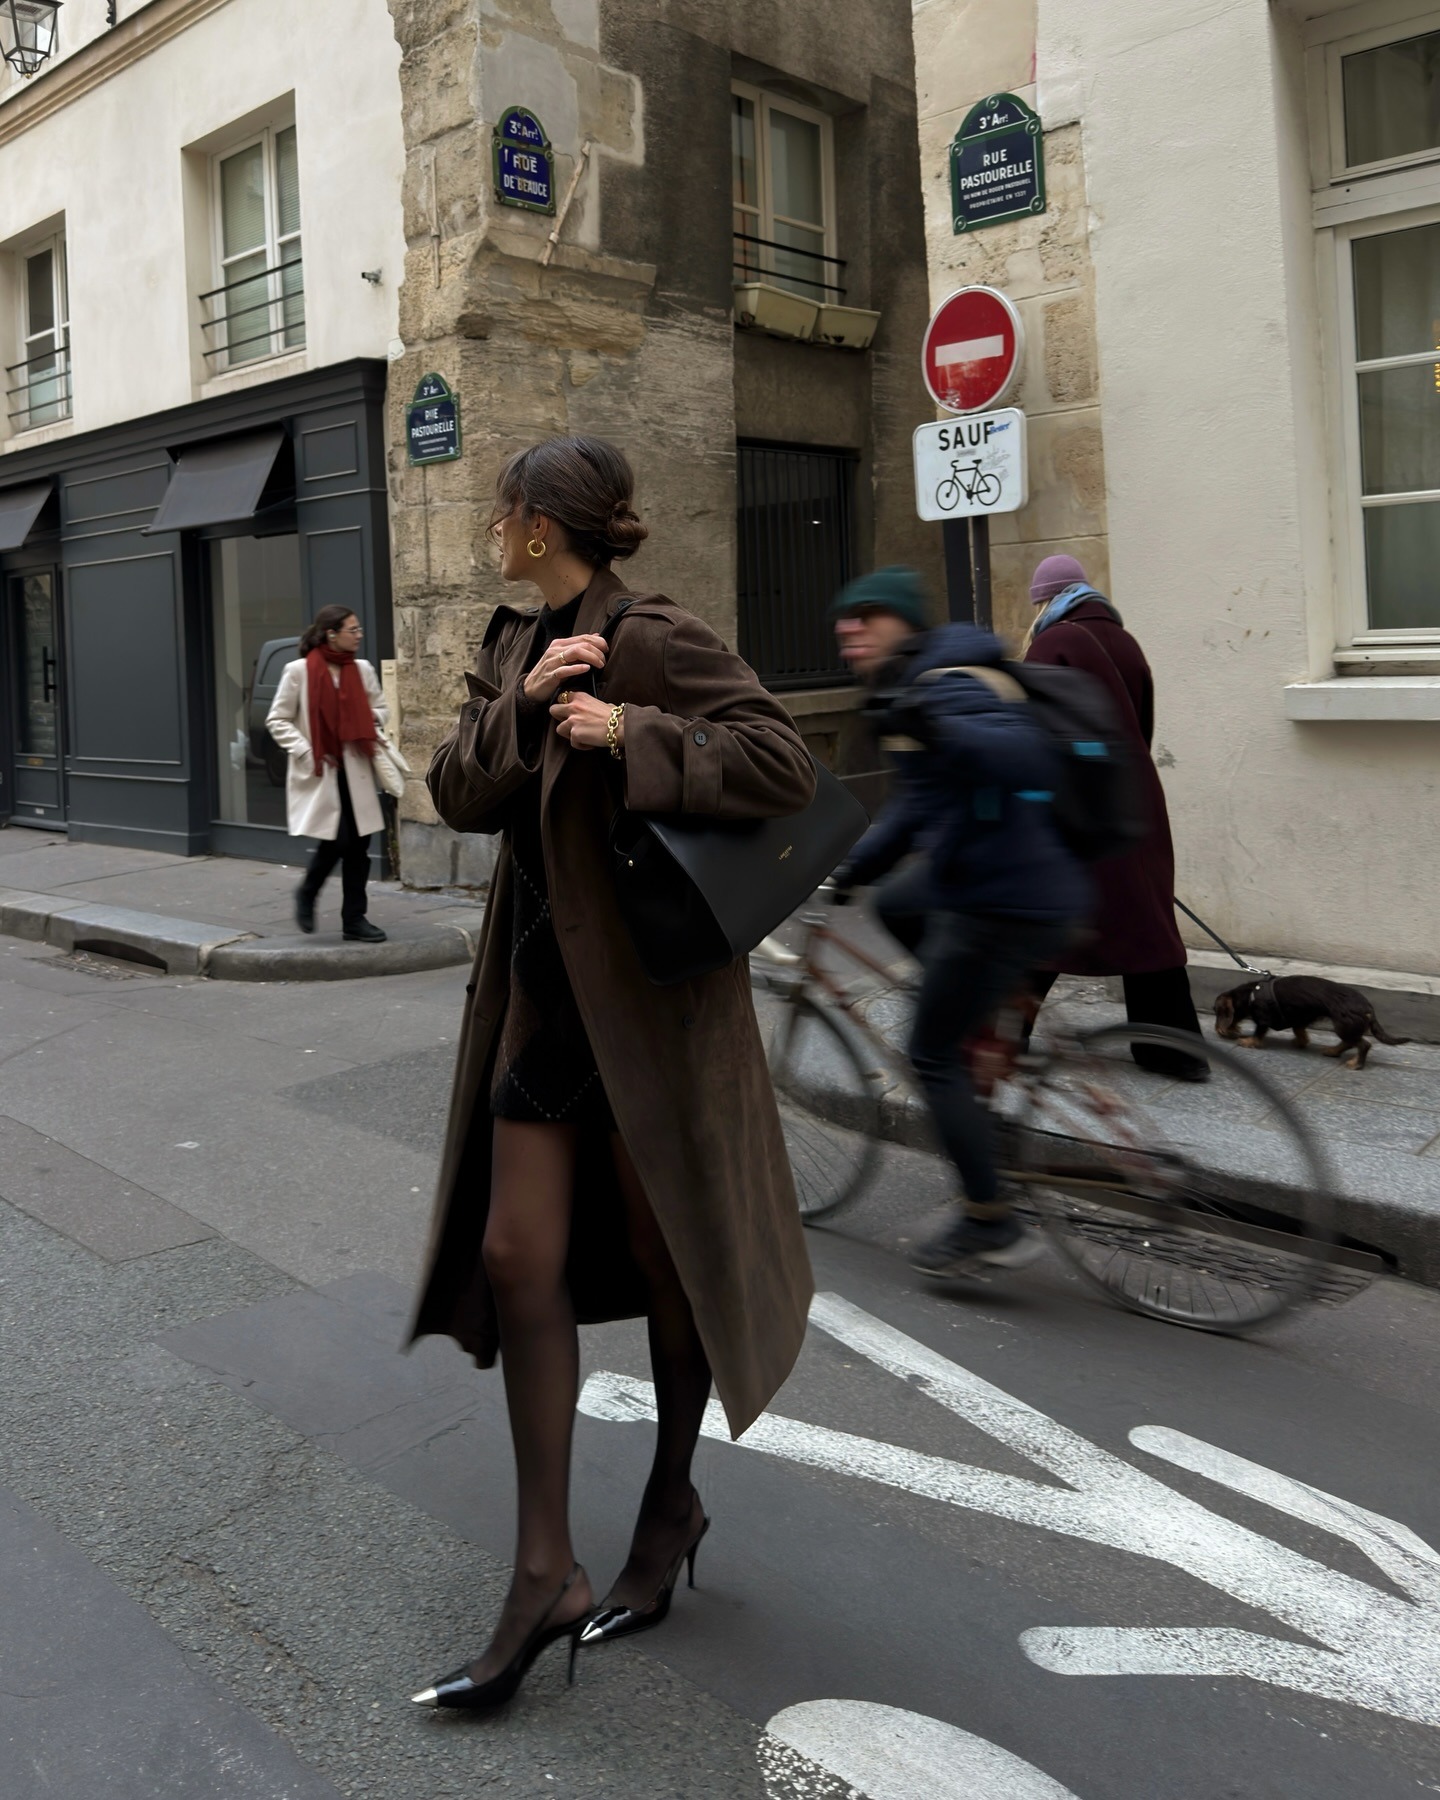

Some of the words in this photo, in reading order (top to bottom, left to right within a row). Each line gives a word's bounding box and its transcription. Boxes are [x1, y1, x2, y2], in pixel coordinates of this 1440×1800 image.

[513, 154, 537, 173] RUE
[983, 149, 1008, 167] RUE
[961, 159, 1033, 190] PASTOURELLE
[503, 174, 515, 189] DE
[517, 177, 548, 197] BEAUCE
[411, 420, 454, 439] PASTOURELLE
[938, 420, 994, 451] SAUF
